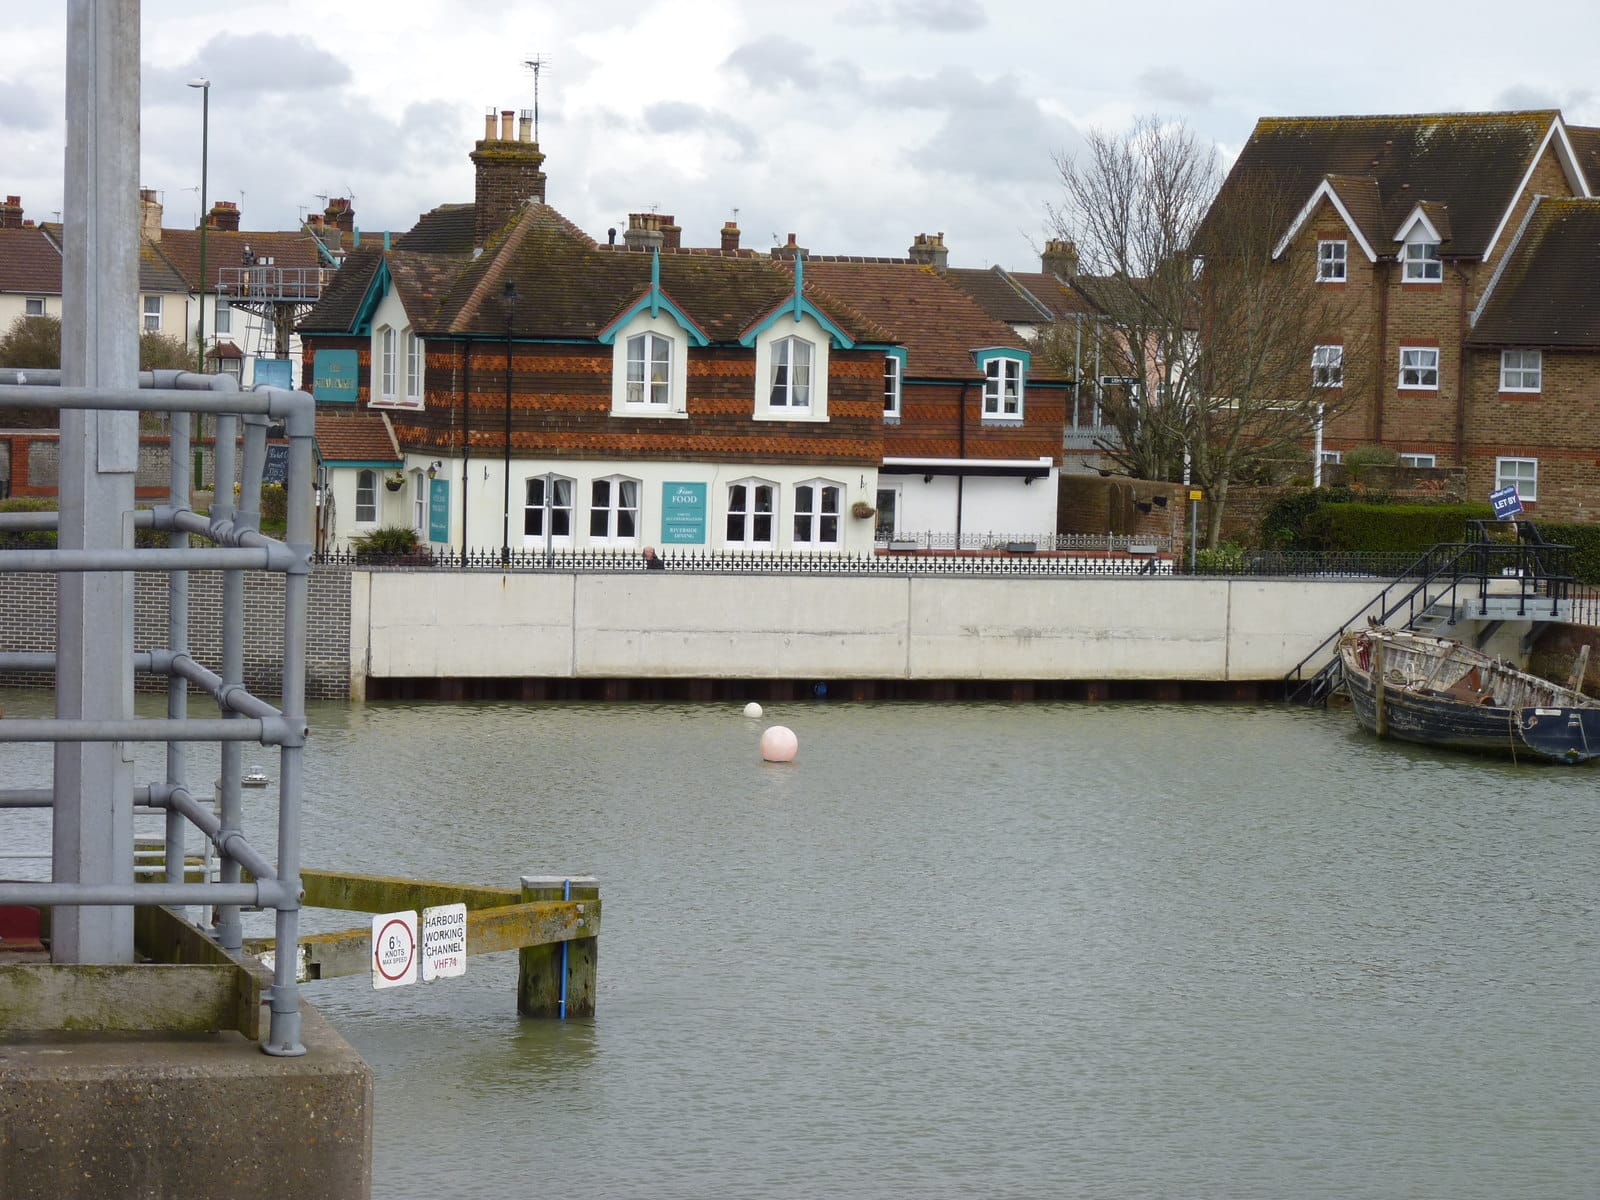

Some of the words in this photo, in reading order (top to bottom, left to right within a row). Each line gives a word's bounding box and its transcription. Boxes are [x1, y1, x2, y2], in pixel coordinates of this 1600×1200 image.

[1494, 499, 1507, 509] LET
[425, 913, 464, 928] HARBOUR
[425, 928, 463, 942] WORKING
[385, 948, 405, 958] KNOTS
[426, 943, 462, 957] CHANNEL
[393, 956, 407, 964] SPEED
